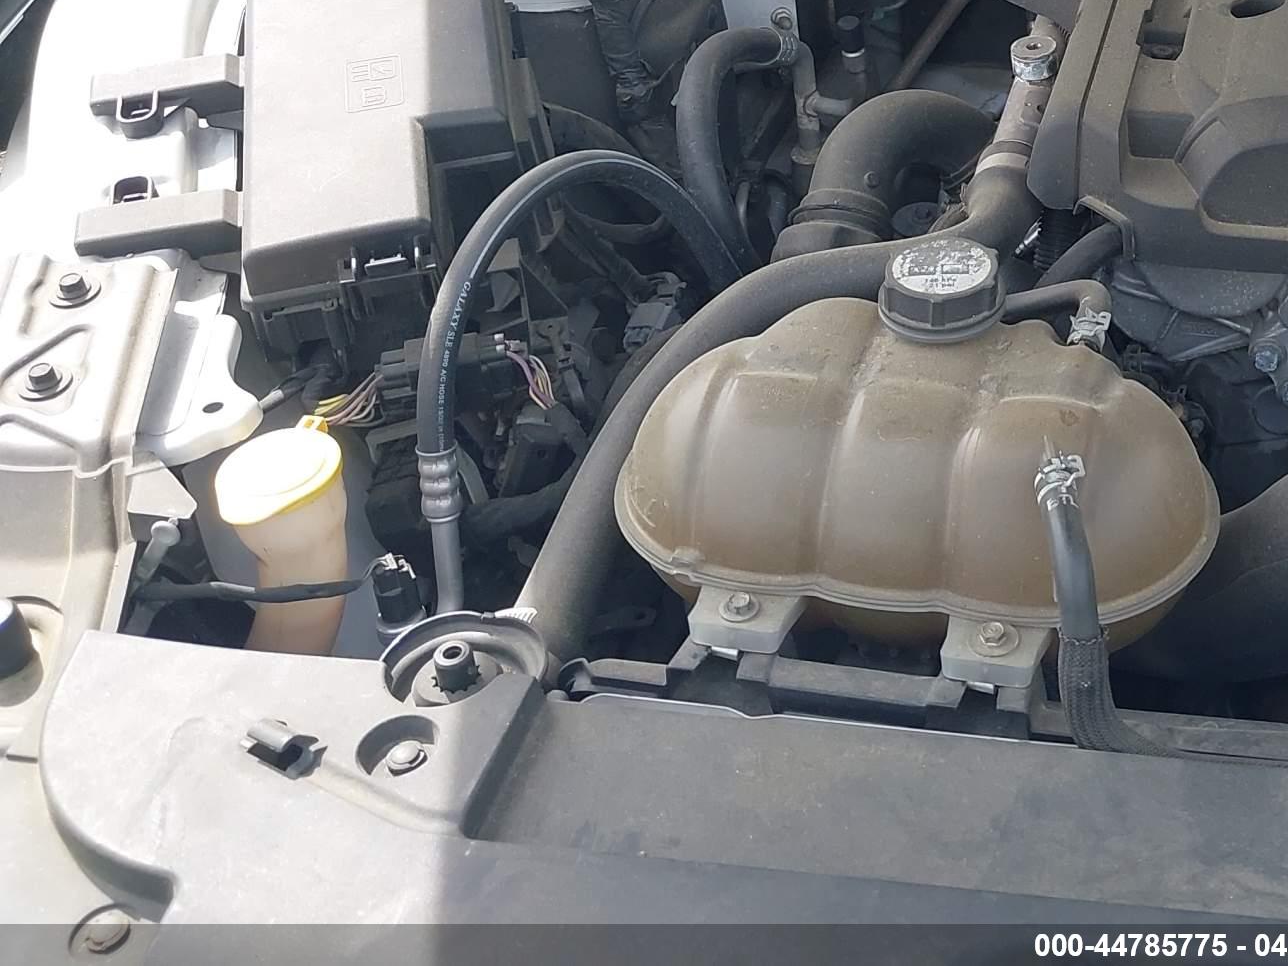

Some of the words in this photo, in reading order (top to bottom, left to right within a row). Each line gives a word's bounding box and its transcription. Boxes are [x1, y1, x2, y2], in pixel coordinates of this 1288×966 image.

[450, 281, 471, 331] GALAXY
[444, 330, 455, 348] SLE
[441, 349, 451, 367] 4890
[440, 368, 448, 383] A/C
[438, 383, 446, 404] HOSE
